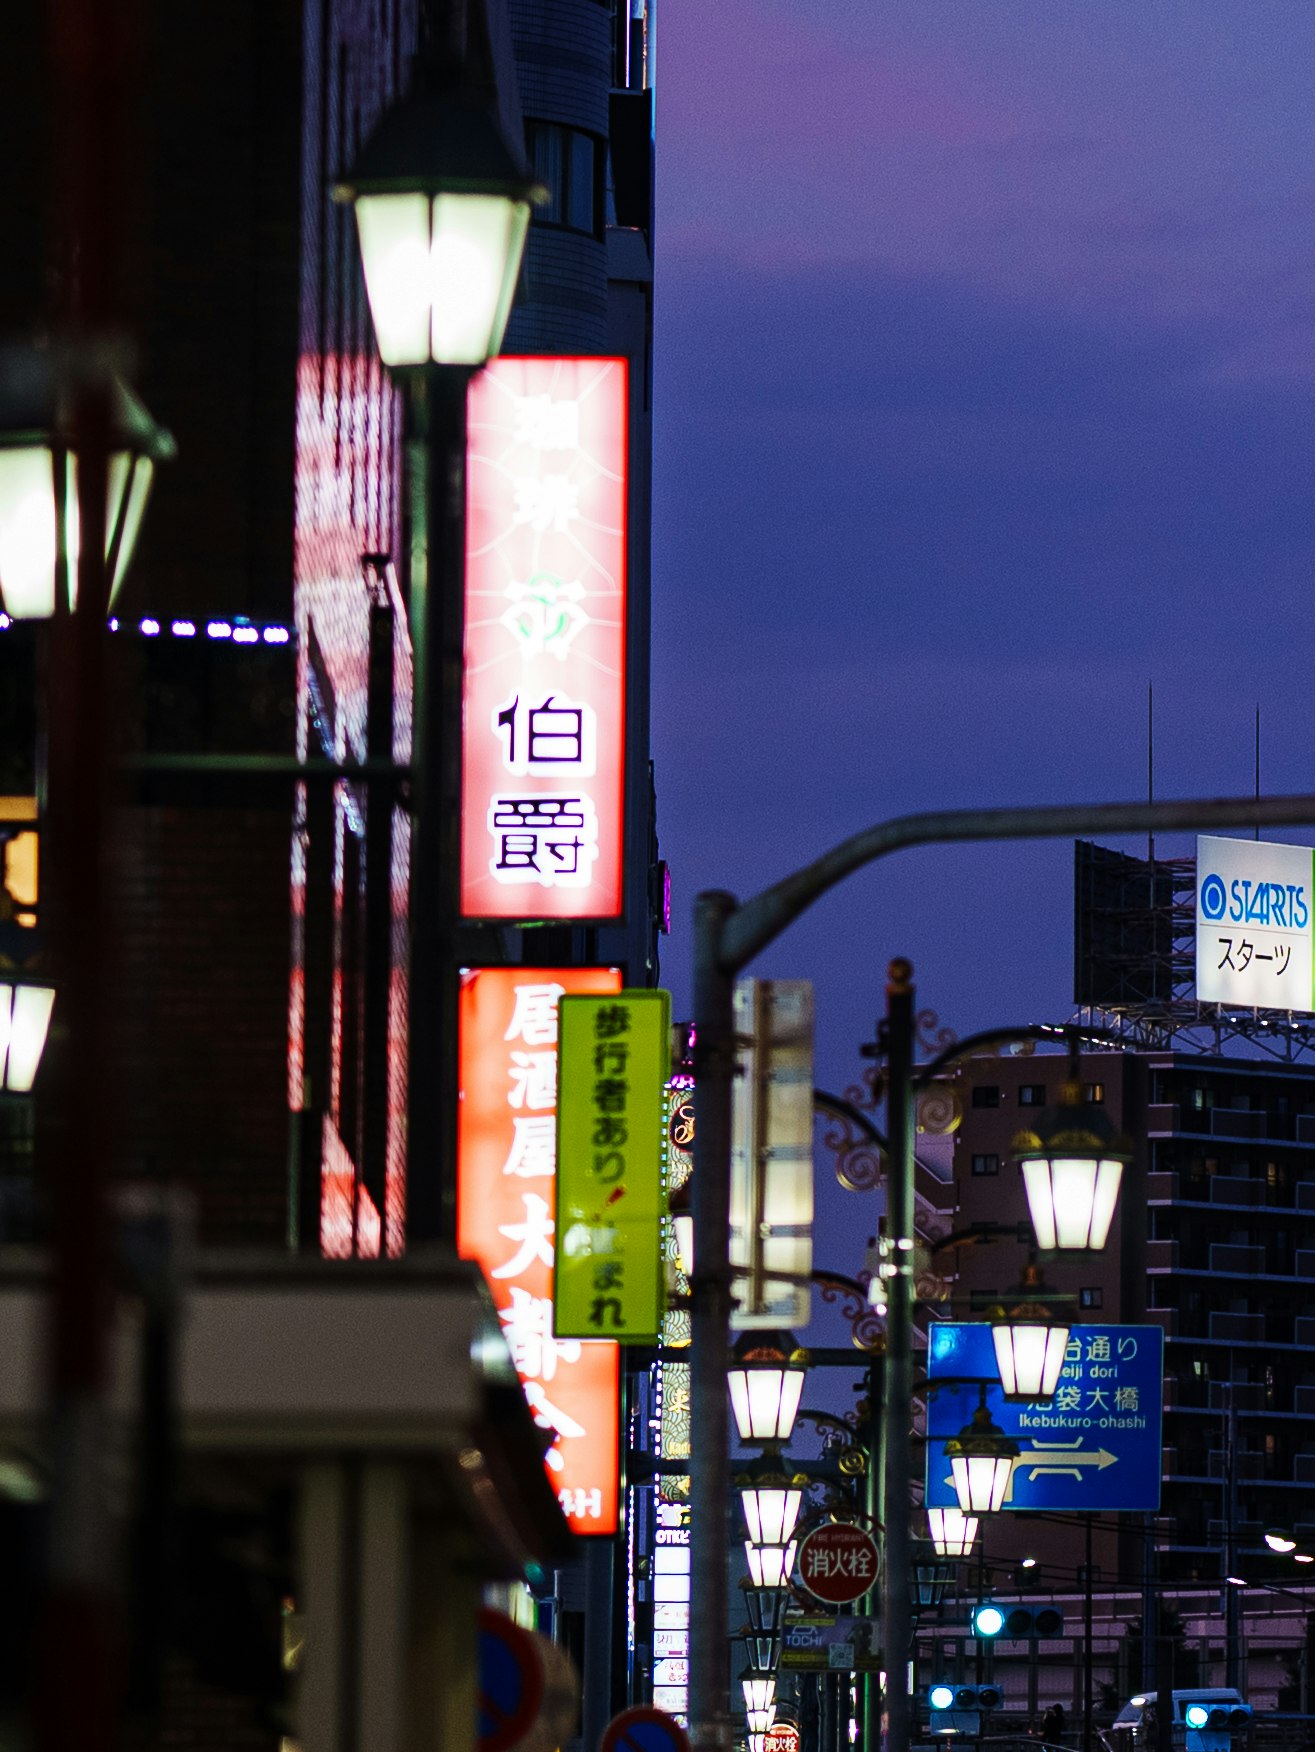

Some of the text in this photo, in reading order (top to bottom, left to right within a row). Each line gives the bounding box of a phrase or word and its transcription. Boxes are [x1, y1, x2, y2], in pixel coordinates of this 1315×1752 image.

[494, 694, 585, 874] 伯爵
[1230, 880, 1308, 928] STARTS
[1218, 938, 1291, 976] スターツ
[1090, 1364, 1118, 1378] dori
[1019, 1413, 1146, 1429] Ikebukuro-ohashi
[807, 1548, 872, 1578] 消火栓
